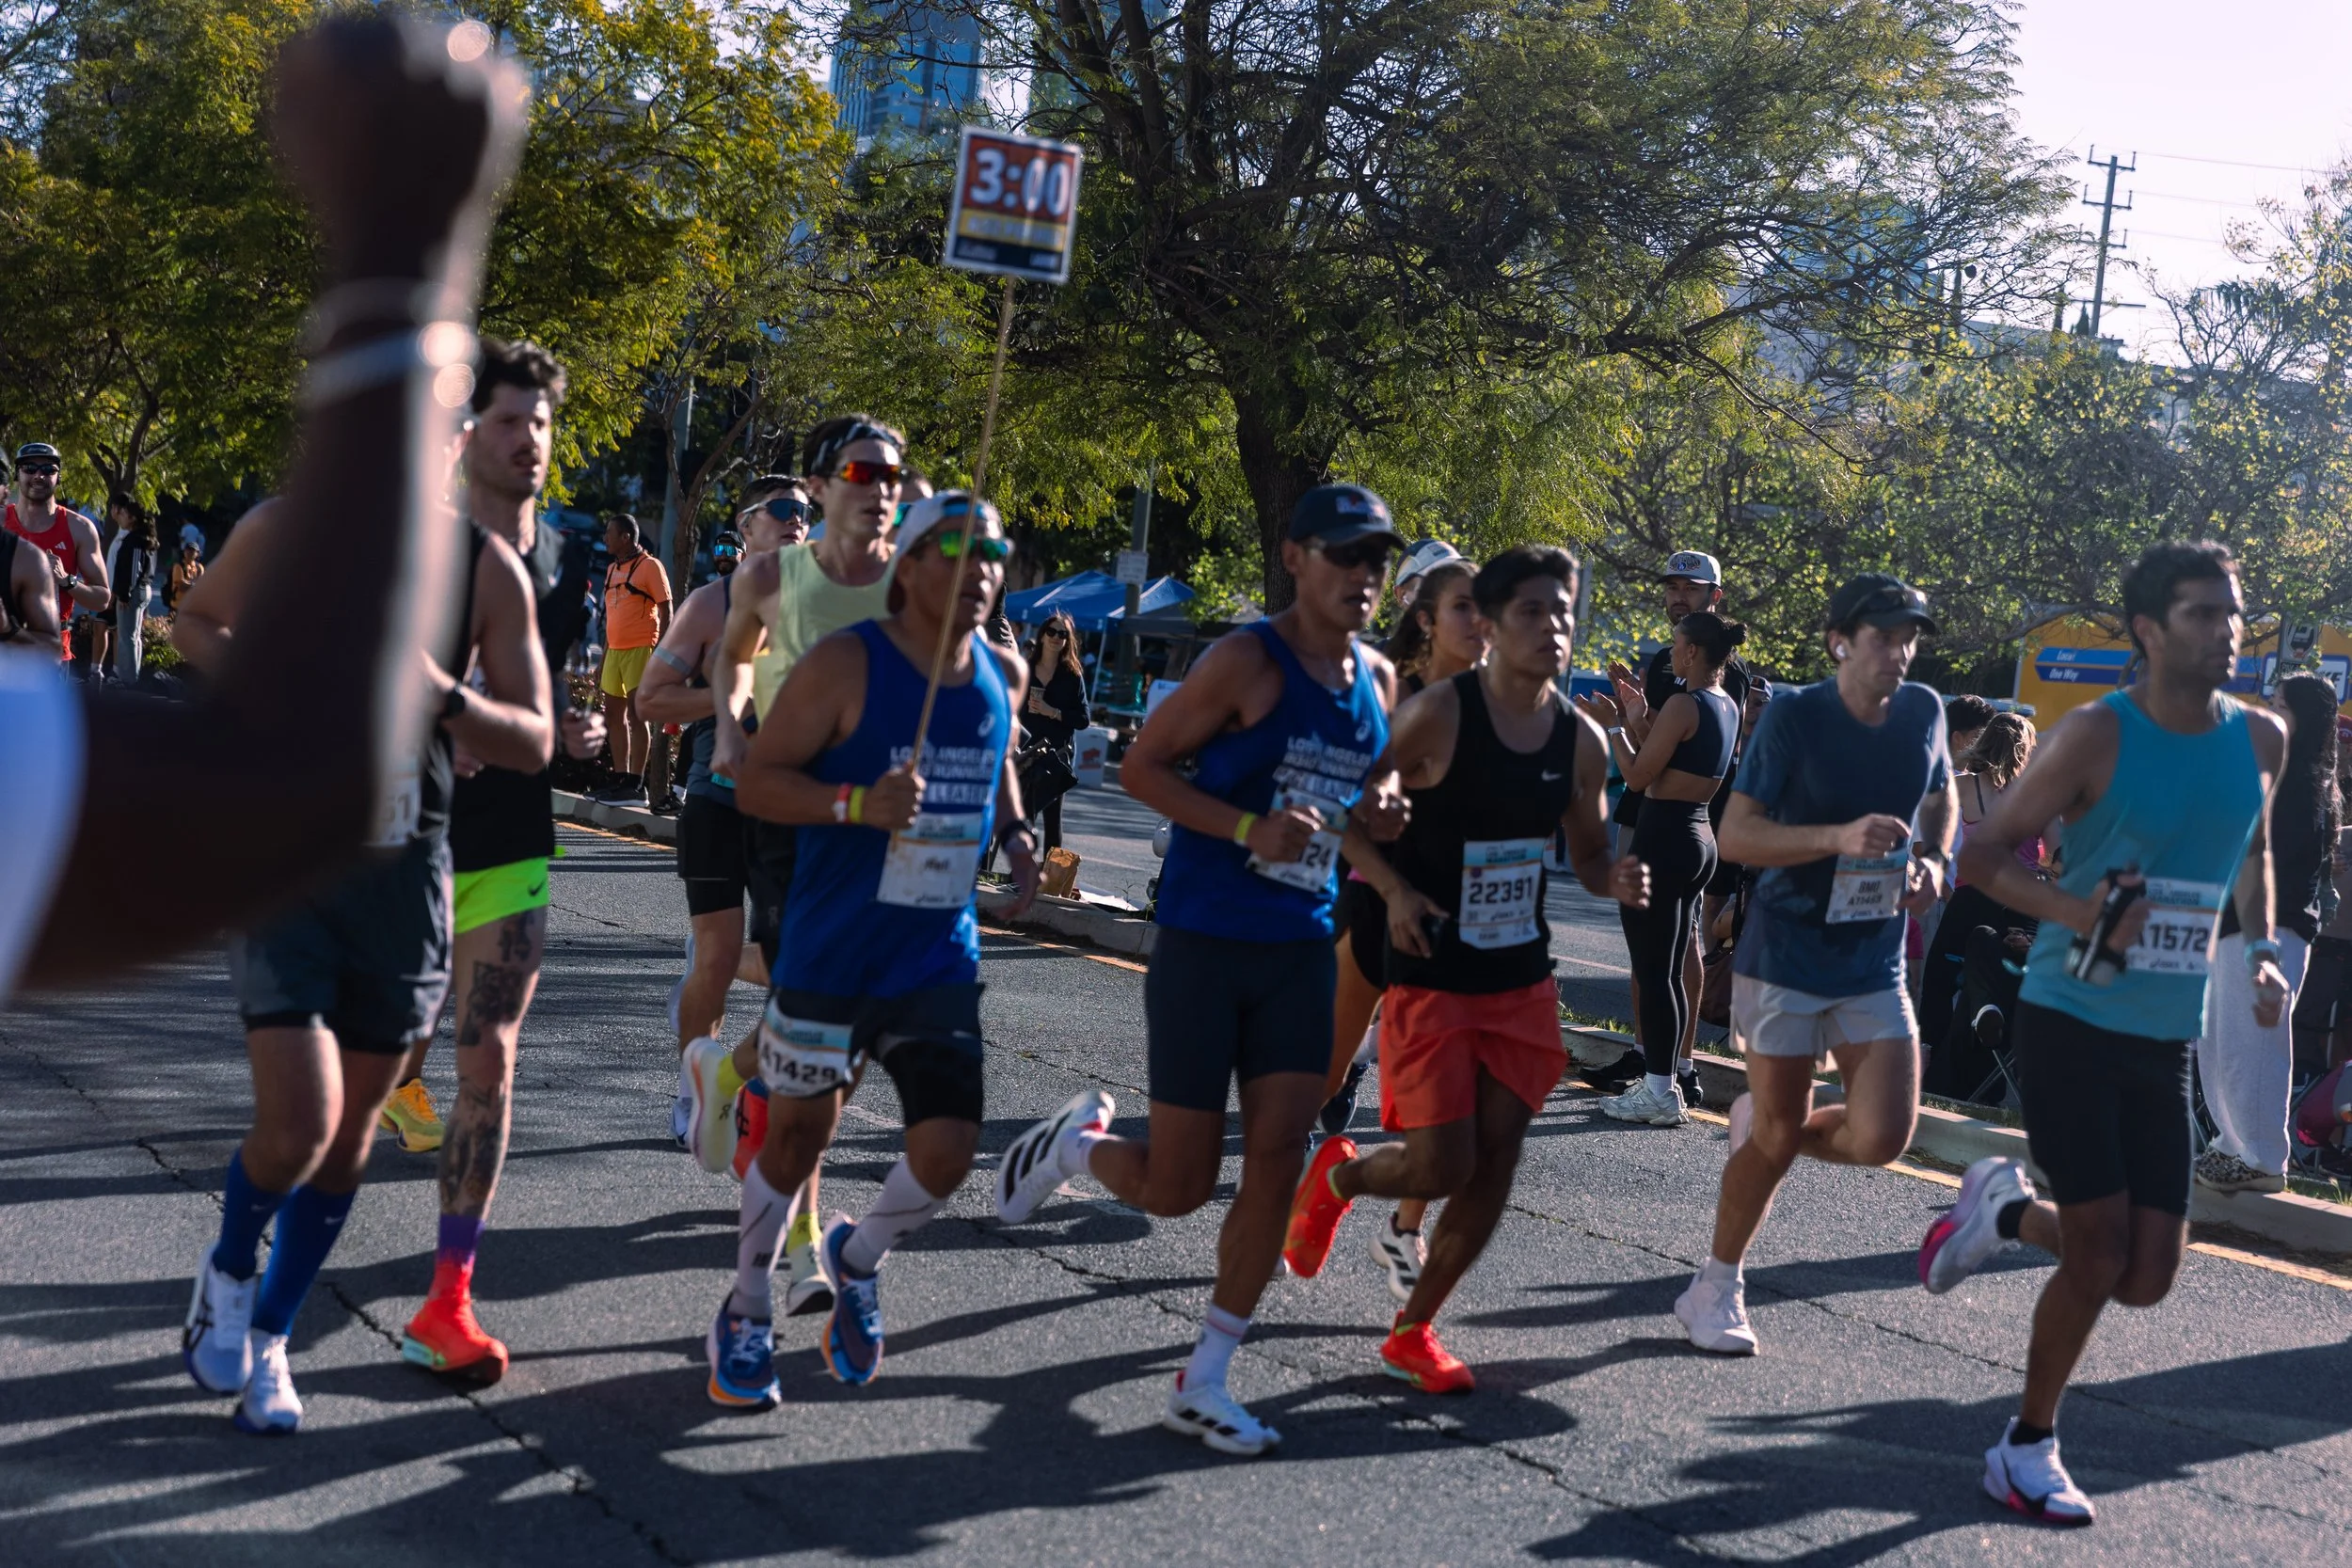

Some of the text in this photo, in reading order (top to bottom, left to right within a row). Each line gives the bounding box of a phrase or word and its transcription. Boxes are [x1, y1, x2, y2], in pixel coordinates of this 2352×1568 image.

[970, 148, 1071, 215] 3:00
[2049, 668, 2079, 682] One Way
[1469, 876, 1533, 904] 22391
